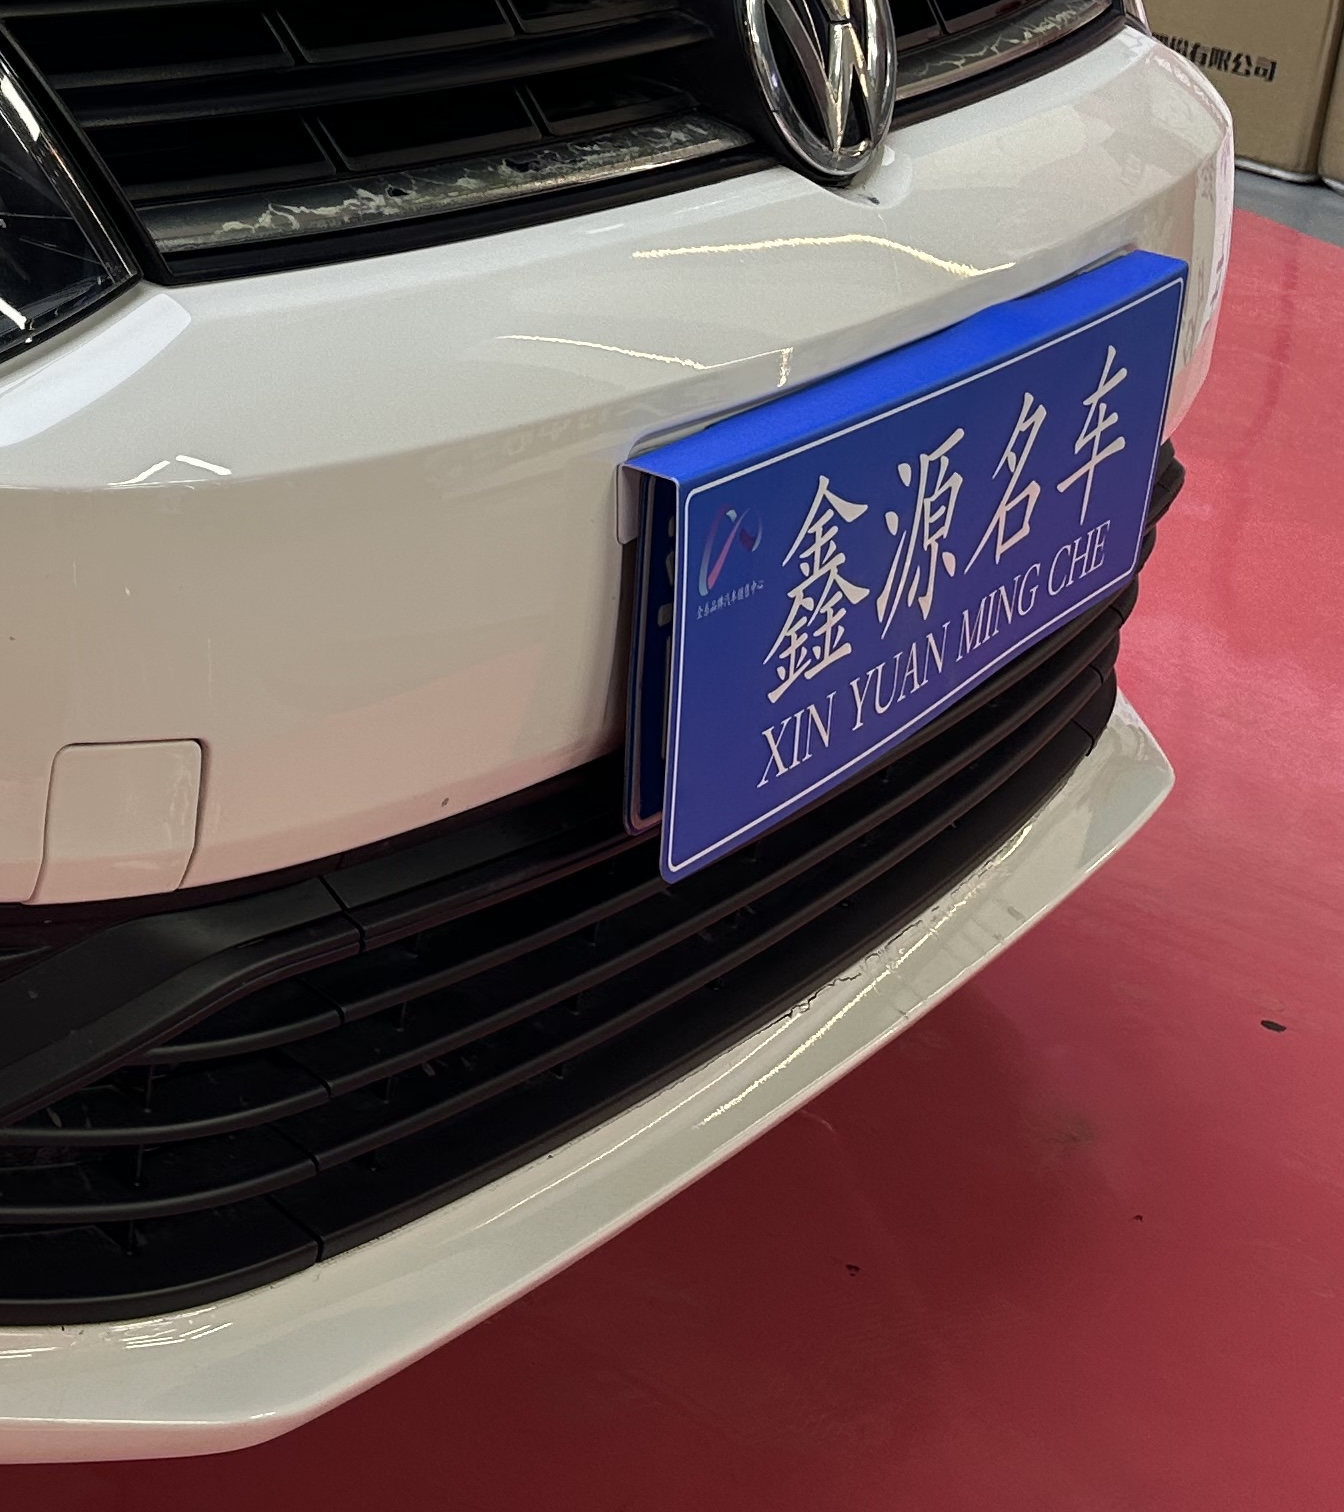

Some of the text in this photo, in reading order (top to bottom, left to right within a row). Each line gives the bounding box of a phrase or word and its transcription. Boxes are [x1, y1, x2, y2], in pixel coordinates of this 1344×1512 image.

[757, 520, 1111, 788] XIN YUAN MING CHE
[763, 345, 1128, 704] 鑫源名车
